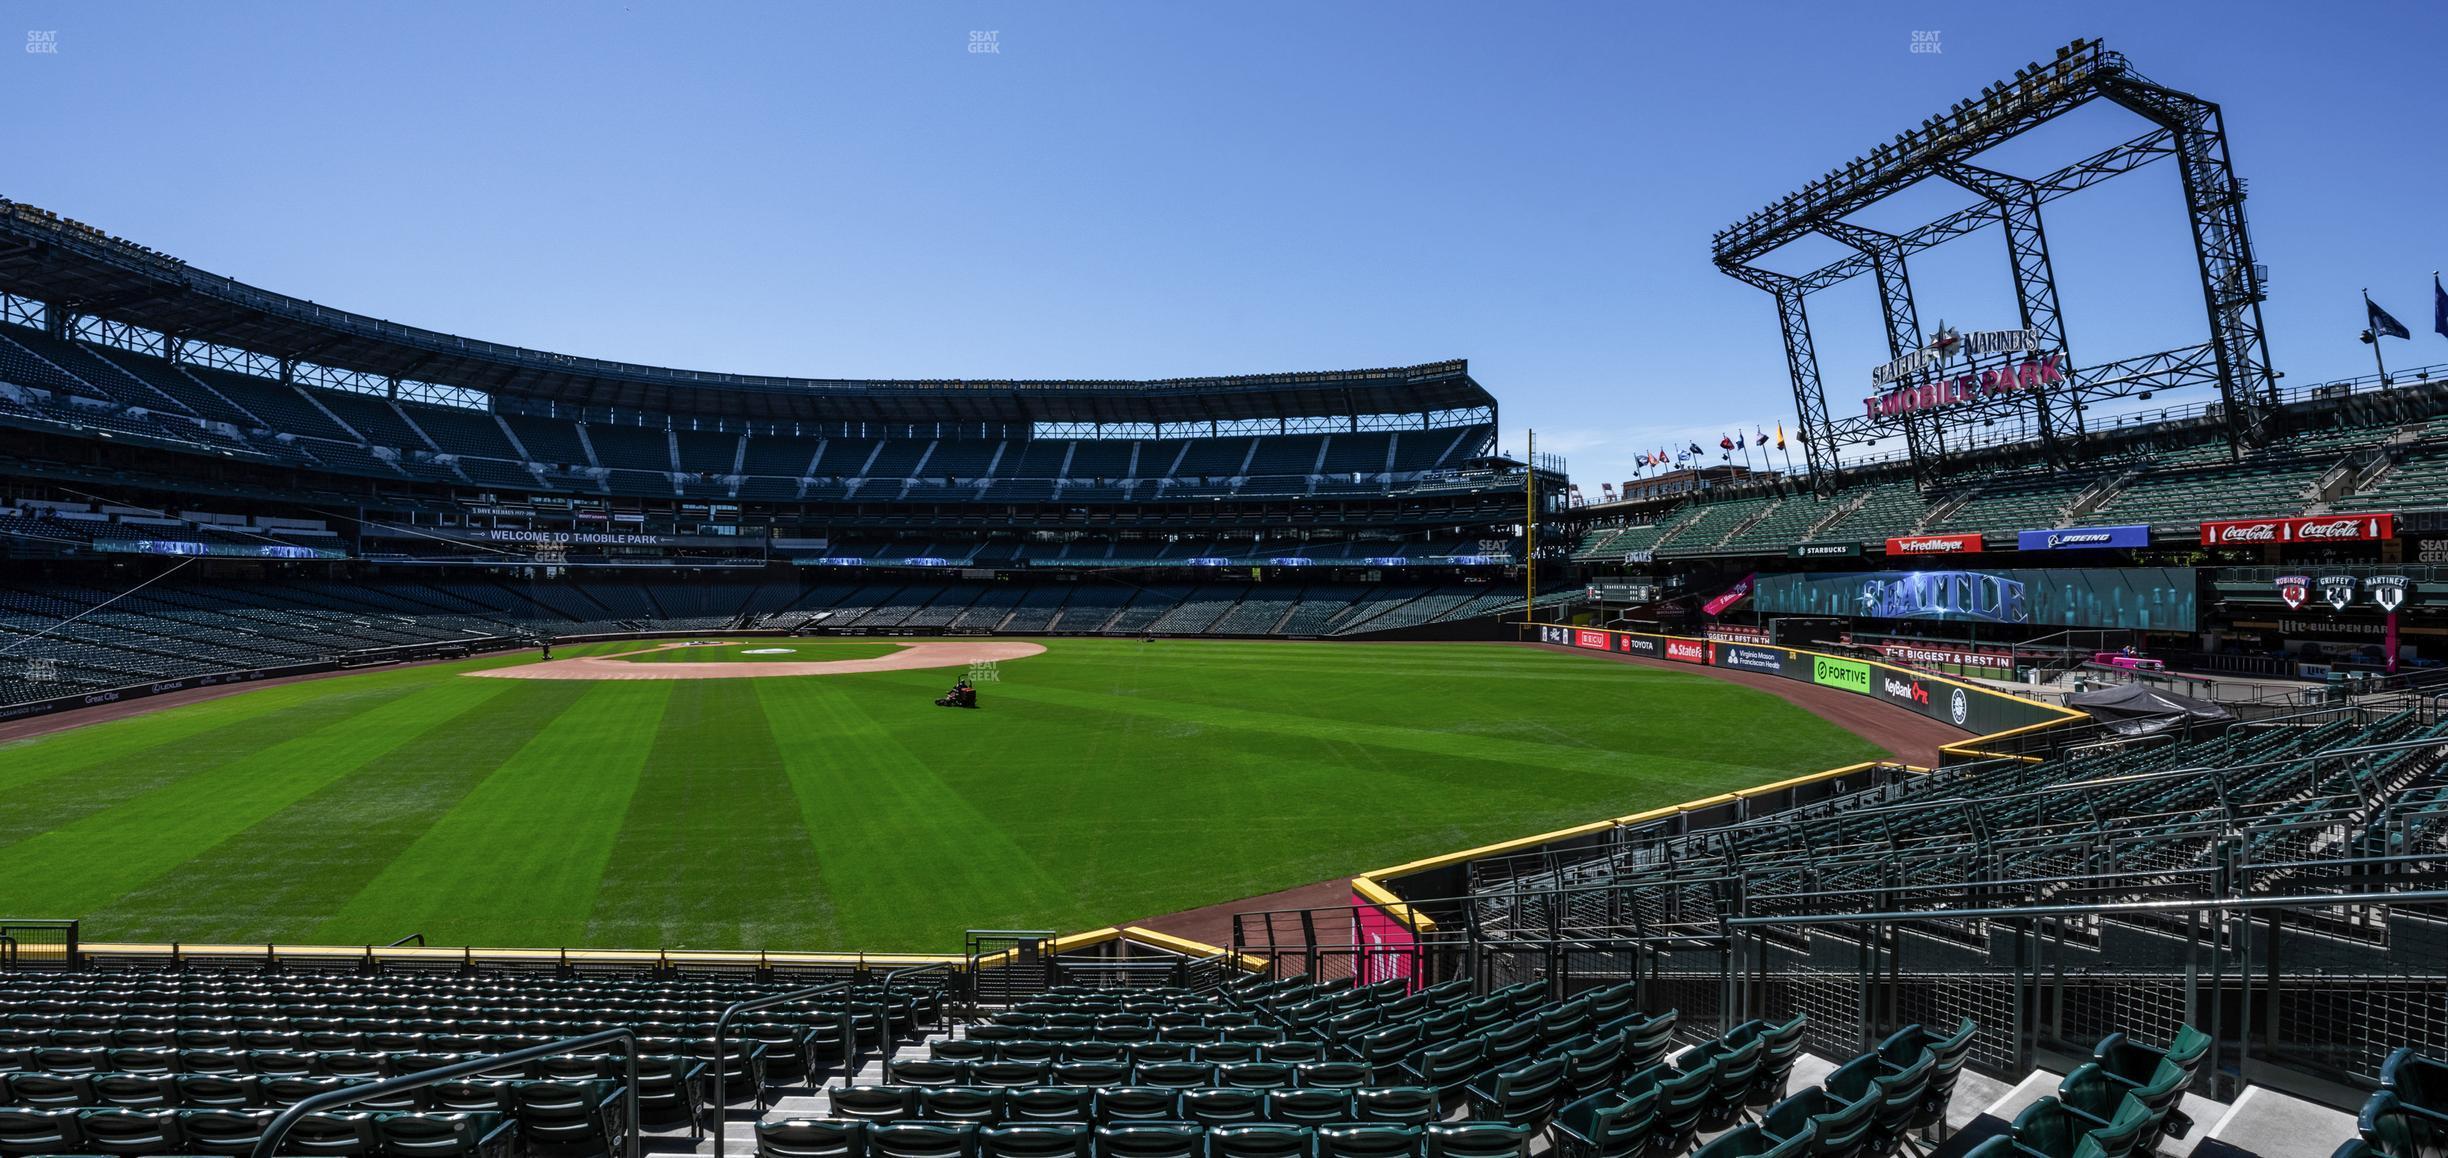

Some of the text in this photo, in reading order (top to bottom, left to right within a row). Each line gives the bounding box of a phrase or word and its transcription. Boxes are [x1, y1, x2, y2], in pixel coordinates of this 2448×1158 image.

[1963, 329, 2039, 355] MARINERS
[1982, 353, 2067, 397] PARK
[2222, 519, 2362, 541] Coca-Cola Coca-Cola
[490, 530, 657, 545] WELCOME TO T-MOBILE PARK
[2063, 533, 2111, 543] BOEING
[1807, 546, 1847, 555] STARBUCKS
[2276, 577, 2306, 586] ROBINSON
[2320, 577, 2349, 585] GRIFFEY
[2366, 576, 2405, 586] MARTINEZ
[2285, 585, 2300, 601] 42
[2329, 587, 2344, 601] 24
[2381, 587, 2395, 605] 11
[2278, 619, 2389, 635] Lite BULLPEN BAR
[1583, 634, 1602, 644] BECU
[1631, 639, 1654, 650] TOYOTA
[1734, 634, 1751, 643] BEST
[1752, 636, 1759, 644] IN
[1739, 650, 1774, 660] Virginia Mason
[1907, 651, 1951, 662] BIGGEST
[1953, 655, 1961, 664] &
[1965, 655, 1994, 665] BEST
[1997, 658, 2009, 667] IN
[1740, 659, 1780, 669] Franciscan Health
[1829, 668, 1866, 684] FORTIVE
[160, 681, 183, 691] LEXUS
[1885, 678, 1912, 700] KeyBank
